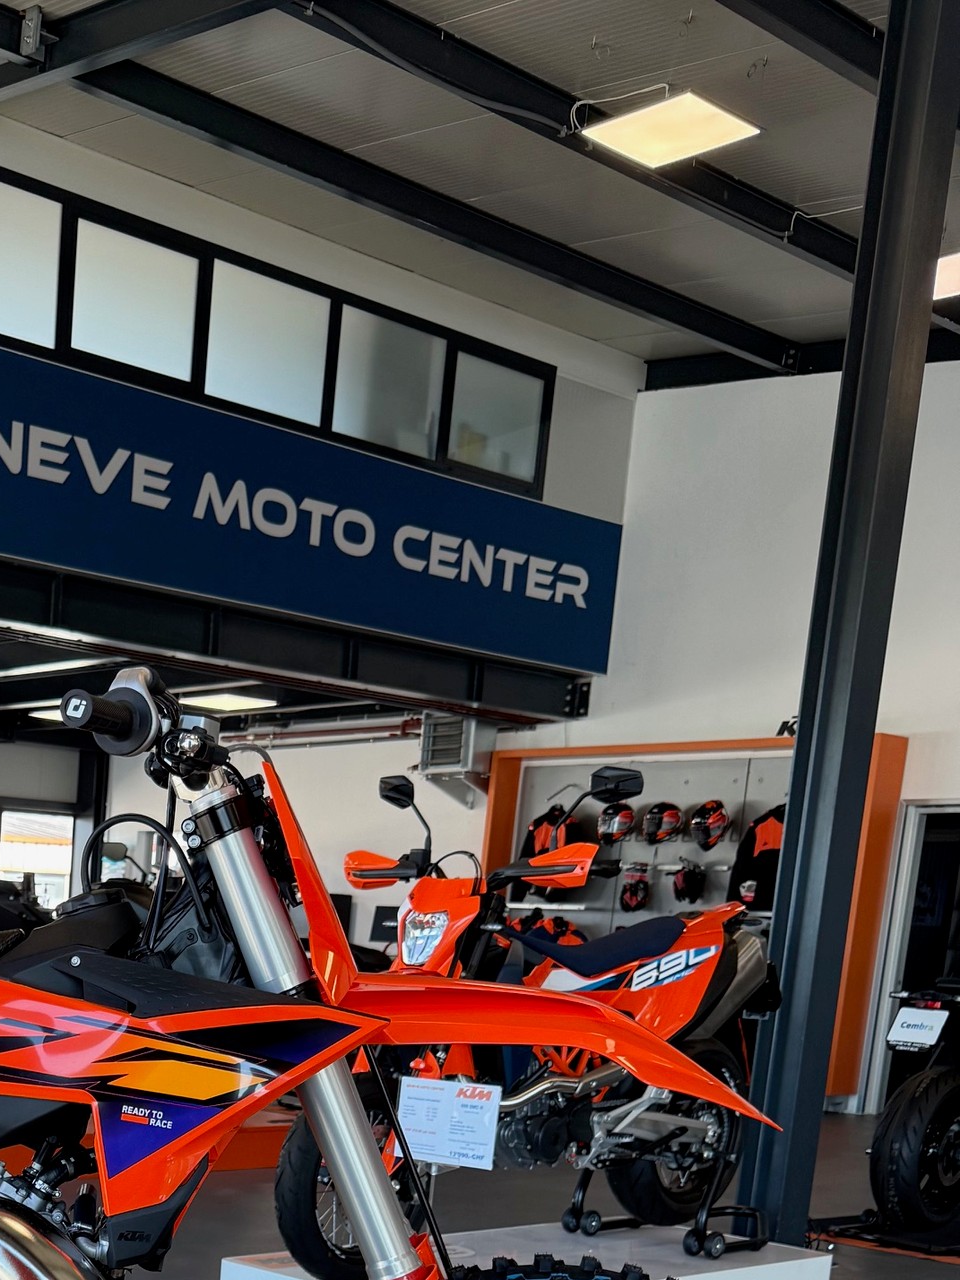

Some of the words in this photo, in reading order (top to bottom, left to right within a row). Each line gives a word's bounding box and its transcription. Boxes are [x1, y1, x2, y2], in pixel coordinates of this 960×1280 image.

[192, 472, 376, 558] MOTO
[393, 525, 589, 610] CENTER
[901, 1021, 934, 1032] Cembra
[455, 1085, 493, 1101] KTM
[122, 1105, 151, 1117] READY
[152, 1110, 163, 1119] TO
[149, 1118, 173, 1129] RACE
